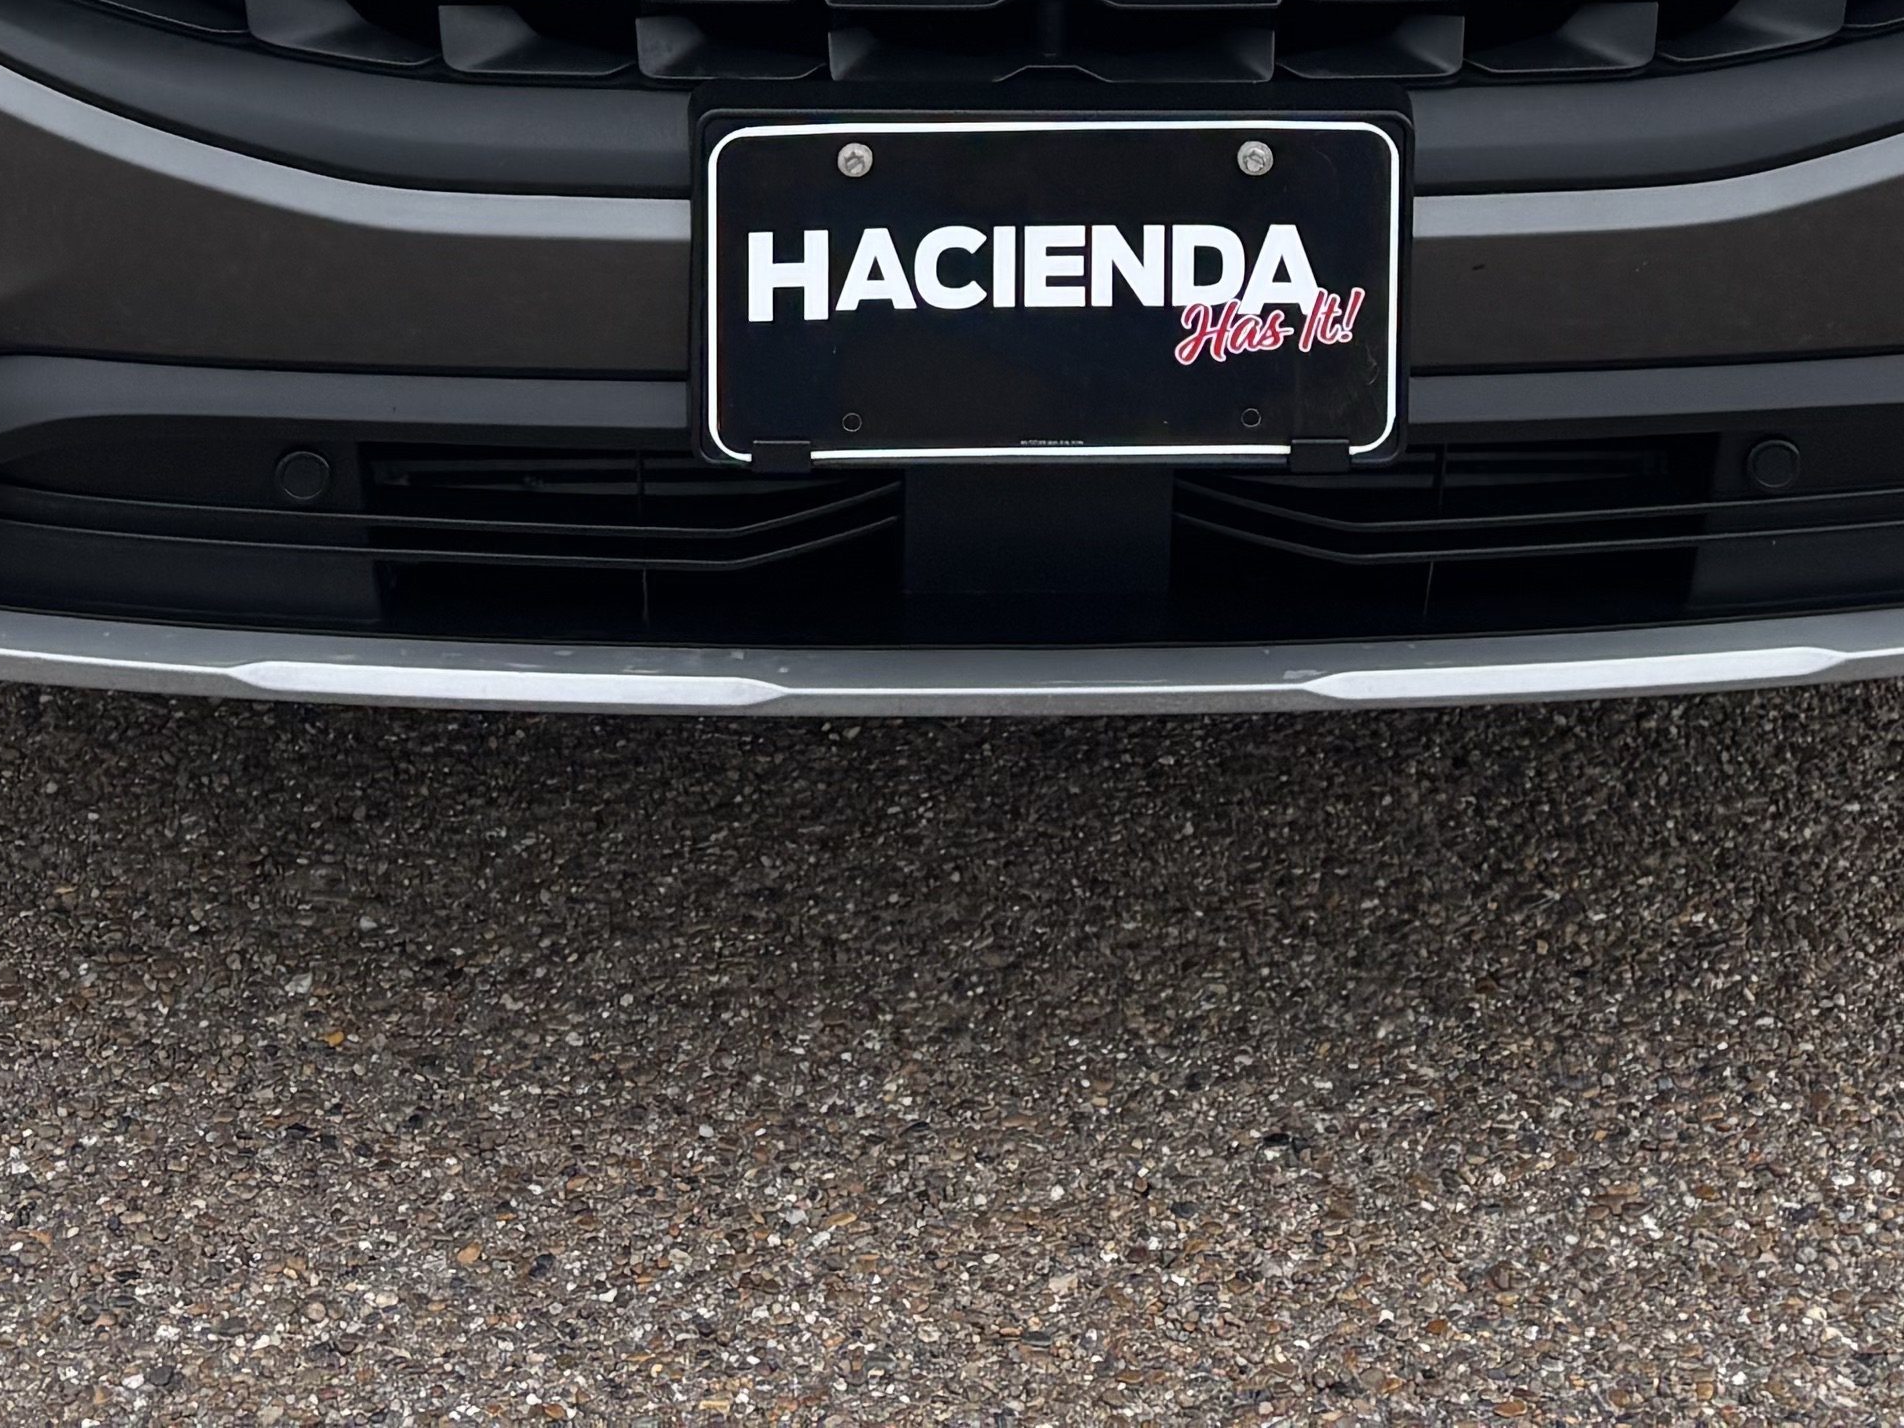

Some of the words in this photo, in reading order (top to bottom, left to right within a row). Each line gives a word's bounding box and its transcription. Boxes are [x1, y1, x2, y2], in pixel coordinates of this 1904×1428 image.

[747, 223, 1318, 322] HACIENDA
[1174, 298, 1295, 366] Has
[1298, 286, 1366, 353] It!
